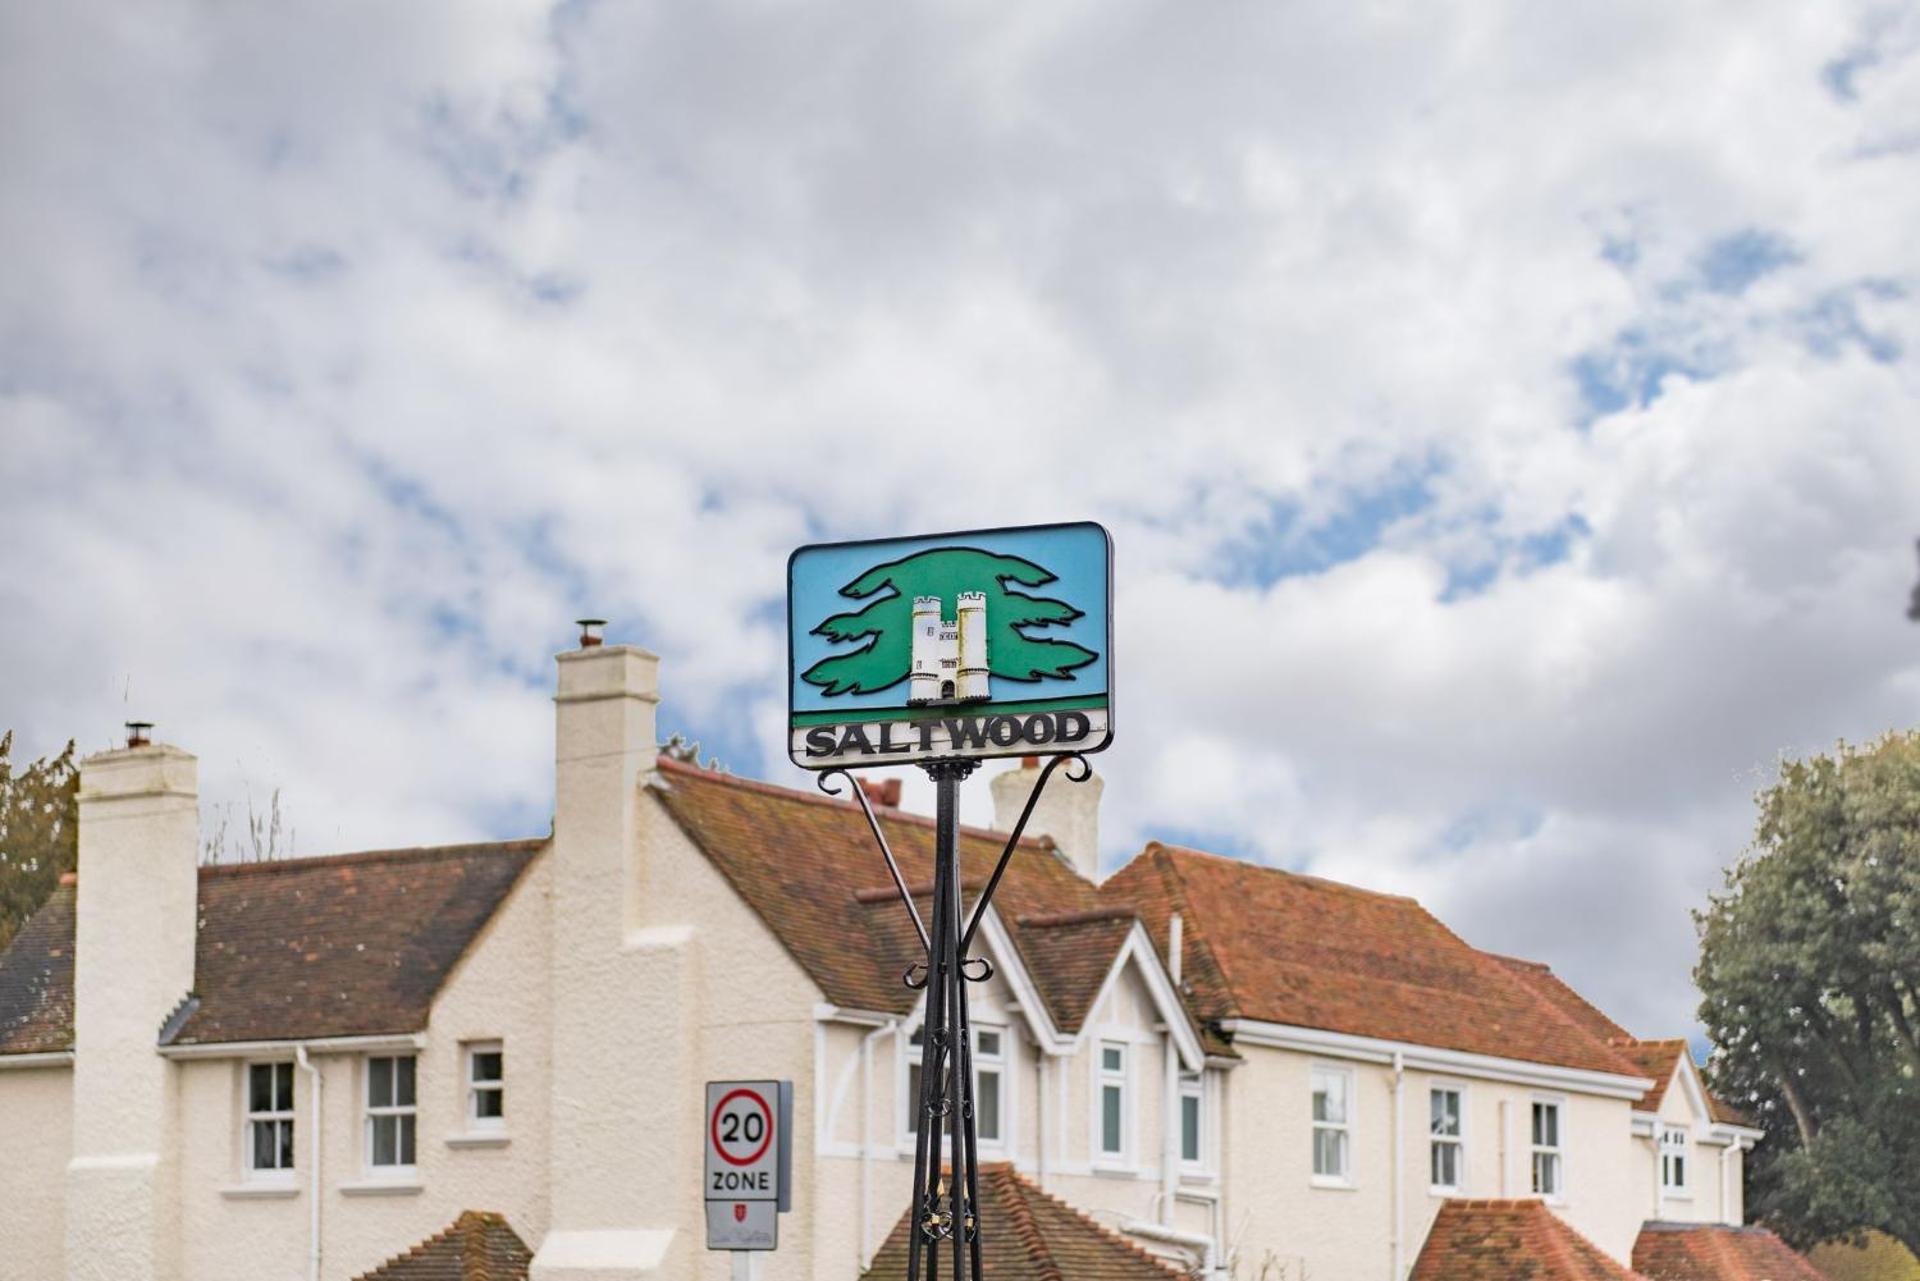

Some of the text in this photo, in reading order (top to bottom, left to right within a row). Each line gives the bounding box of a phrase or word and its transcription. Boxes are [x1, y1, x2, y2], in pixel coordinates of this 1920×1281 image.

[806, 711, 1091, 758] SALTWOOD
[722, 1113, 764, 1142] 20
[713, 1172, 770, 1190] ZONE
